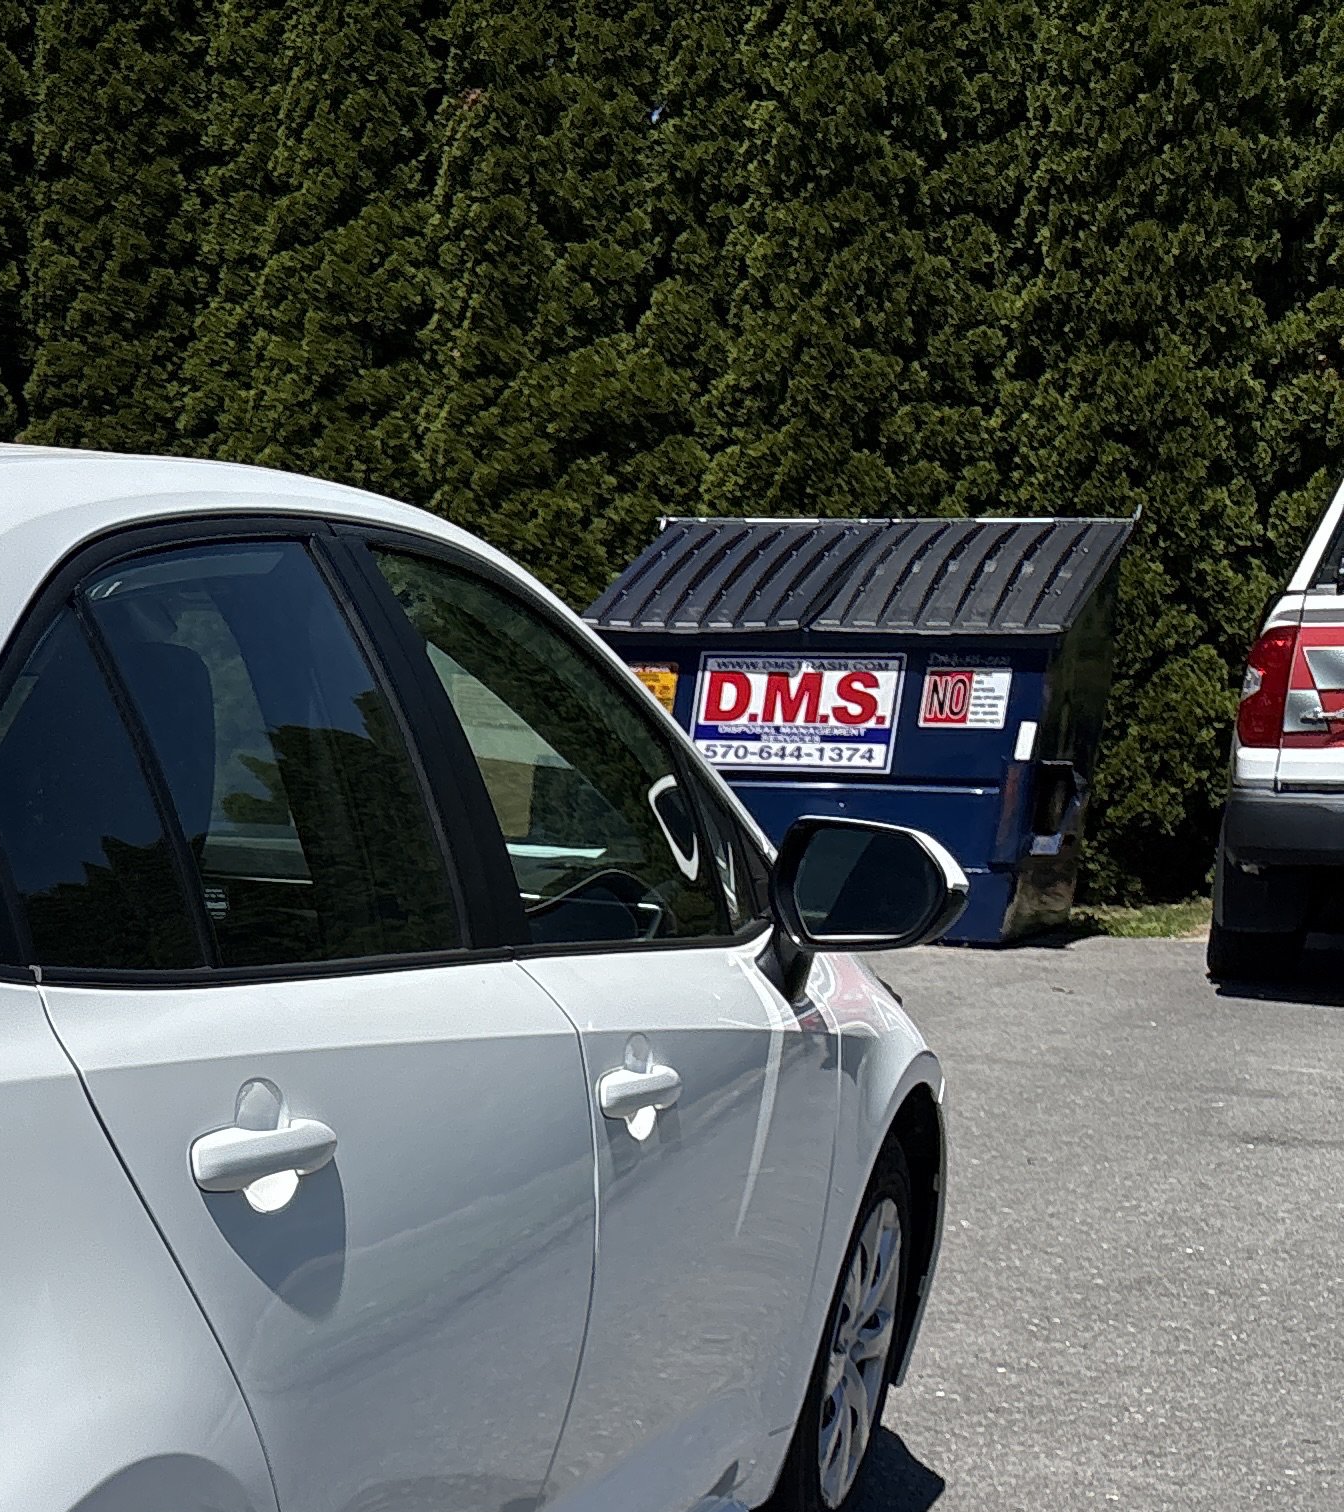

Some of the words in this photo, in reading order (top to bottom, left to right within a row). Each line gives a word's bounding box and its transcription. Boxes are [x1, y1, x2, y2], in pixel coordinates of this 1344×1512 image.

[703, 671, 887, 725] D.M.S.
[925, 674, 970, 719] NO
[704, 743, 875, 763] 570-644-1374
